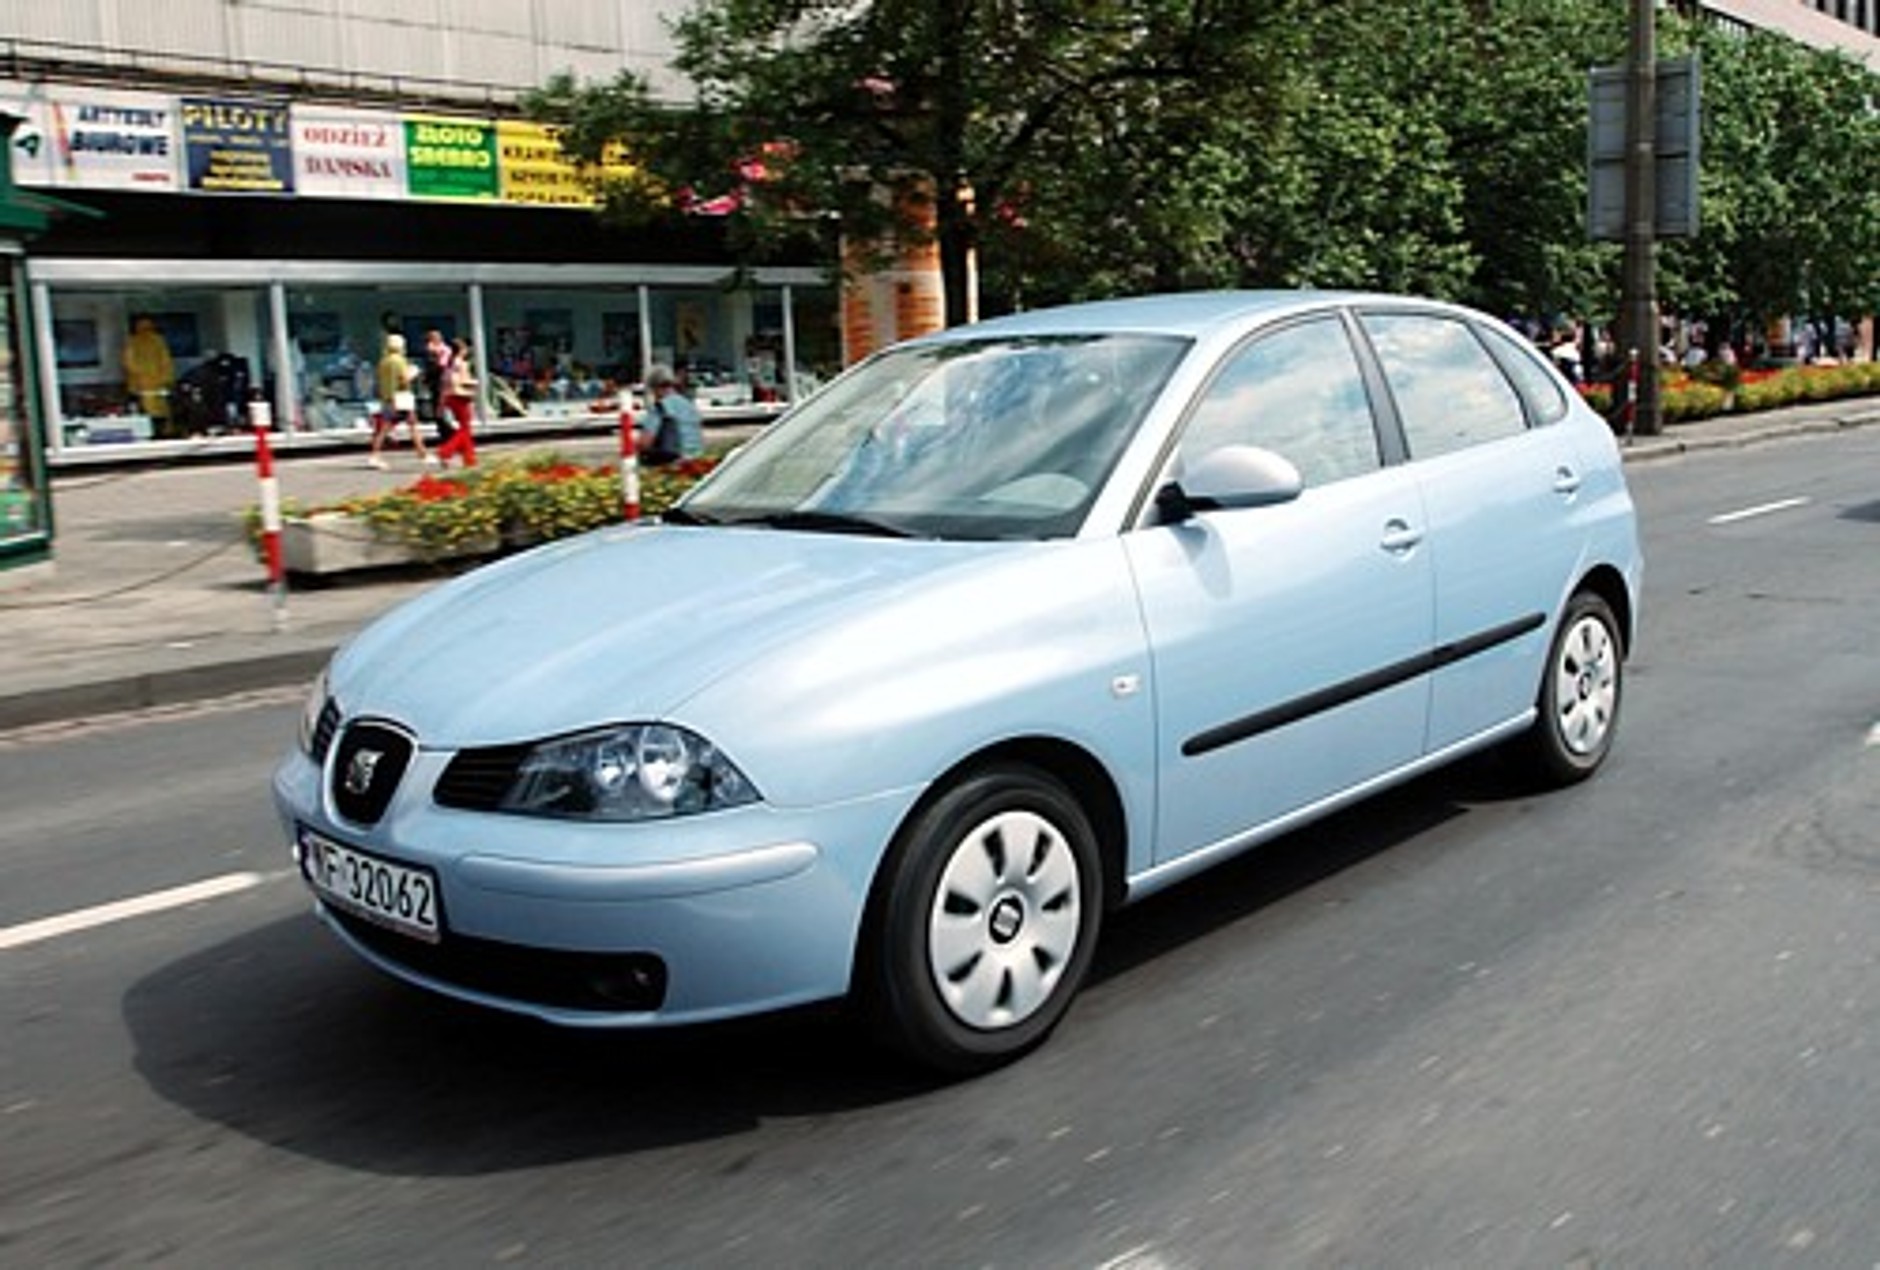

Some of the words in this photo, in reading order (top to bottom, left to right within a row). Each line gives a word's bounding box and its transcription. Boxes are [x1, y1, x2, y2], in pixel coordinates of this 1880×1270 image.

[183, 103, 288, 133] PILOTY
[69, 131, 169, 157] BIUROWE
[305, 156, 392, 178] DAMSKA
[345, 854, 434, 926] 32062
